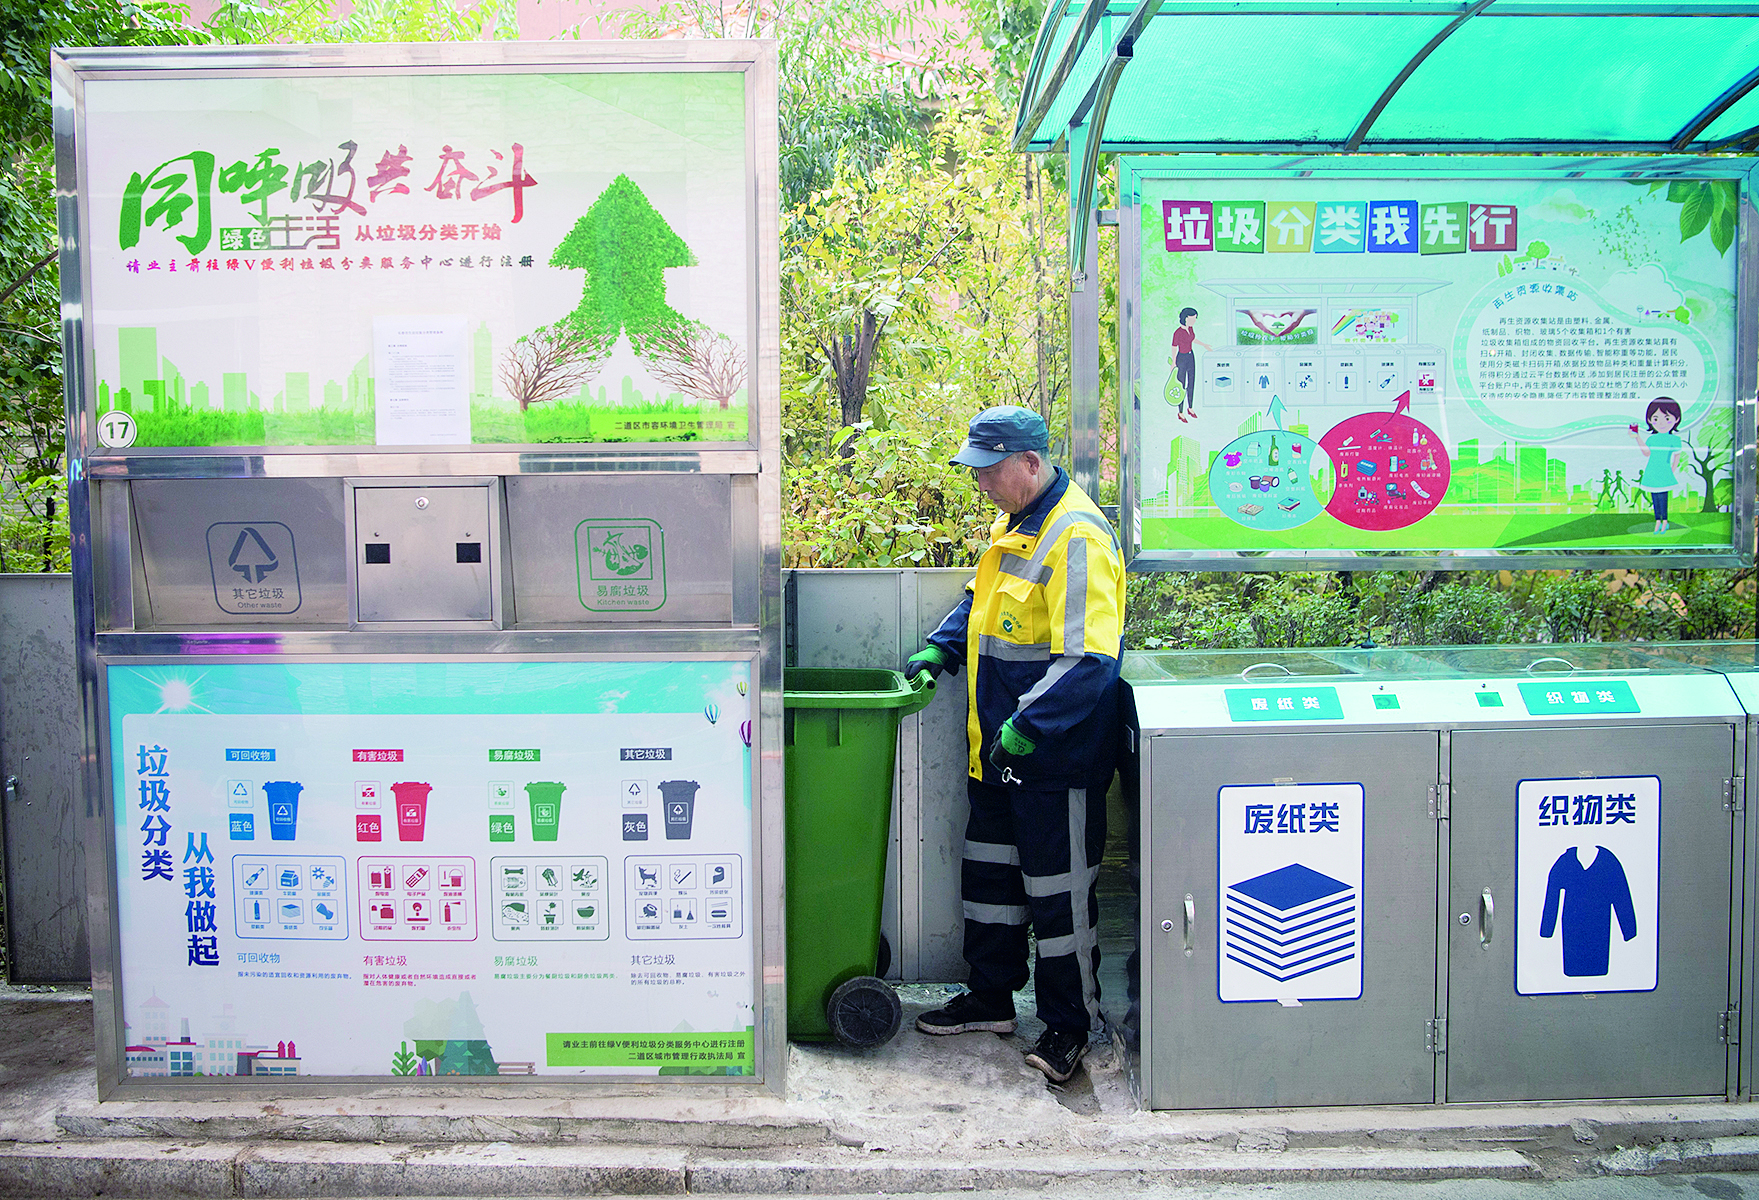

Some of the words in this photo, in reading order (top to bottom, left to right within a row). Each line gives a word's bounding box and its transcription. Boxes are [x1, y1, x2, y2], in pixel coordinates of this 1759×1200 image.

[119, 140, 538, 256] 同呼吸共奋斗
[1167, 205, 1512, 246] 垃圾分类我先行
[221, 214, 340, 250] 绿色生活
[355, 224, 502, 241] 从垃圾分类开始
[126, 255, 534, 273] 请业主前往绿V便利垃圾分类服务中心进行注册
[1492, 283, 1578, 309] 再生资源收集站
[105, 421, 129, 439] 17
[615, 421, 723, 430] 二道区市容环境卫生管理局
[232, 588, 284, 600] 其它垃圾
[597, 585, 649, 597] 易腐垃圾
[237, 601, 258, 609] Other
[1251, 697, 1320, 710] 废纸类
[1546, 691, 1616, 704] 织物类
[230, 750, 271, 760] 可回收物
[357, 750, 398, 761] 有害垃圾
[493, 750, 534, 761] 易腐垃圾
[624, 749, 666, 760] 其它垃圾
[136, 744, 174, 882] 垃圾分类
[1538, 793, 1636, 827] 织物类
[1244, 802, 1340, 834] 废纸类
[231, 820, 253, 832] 蓝色
[357, 822, 380, 834] 红色
[491, 822, 514, 834] 绿色
[624, 821, 647, 833] 灰色
[183, 832, 220, 967] 从我做起
[236, 952, 281, 964] 可回收物
[363, 955, 407, 967] 有害垃圾
[494, 956, 538, 967] 易腐垃圾
[630, 954, 676, 966] 其它垃圾
[563, 1040, 745, 1049] 请业主前往绿V便利垃圾分类服务中心进行注册
[628, 1052, 734, 1061] 二道区城市管理行政执法局
[737, 1052, 746, 1060] 宣
